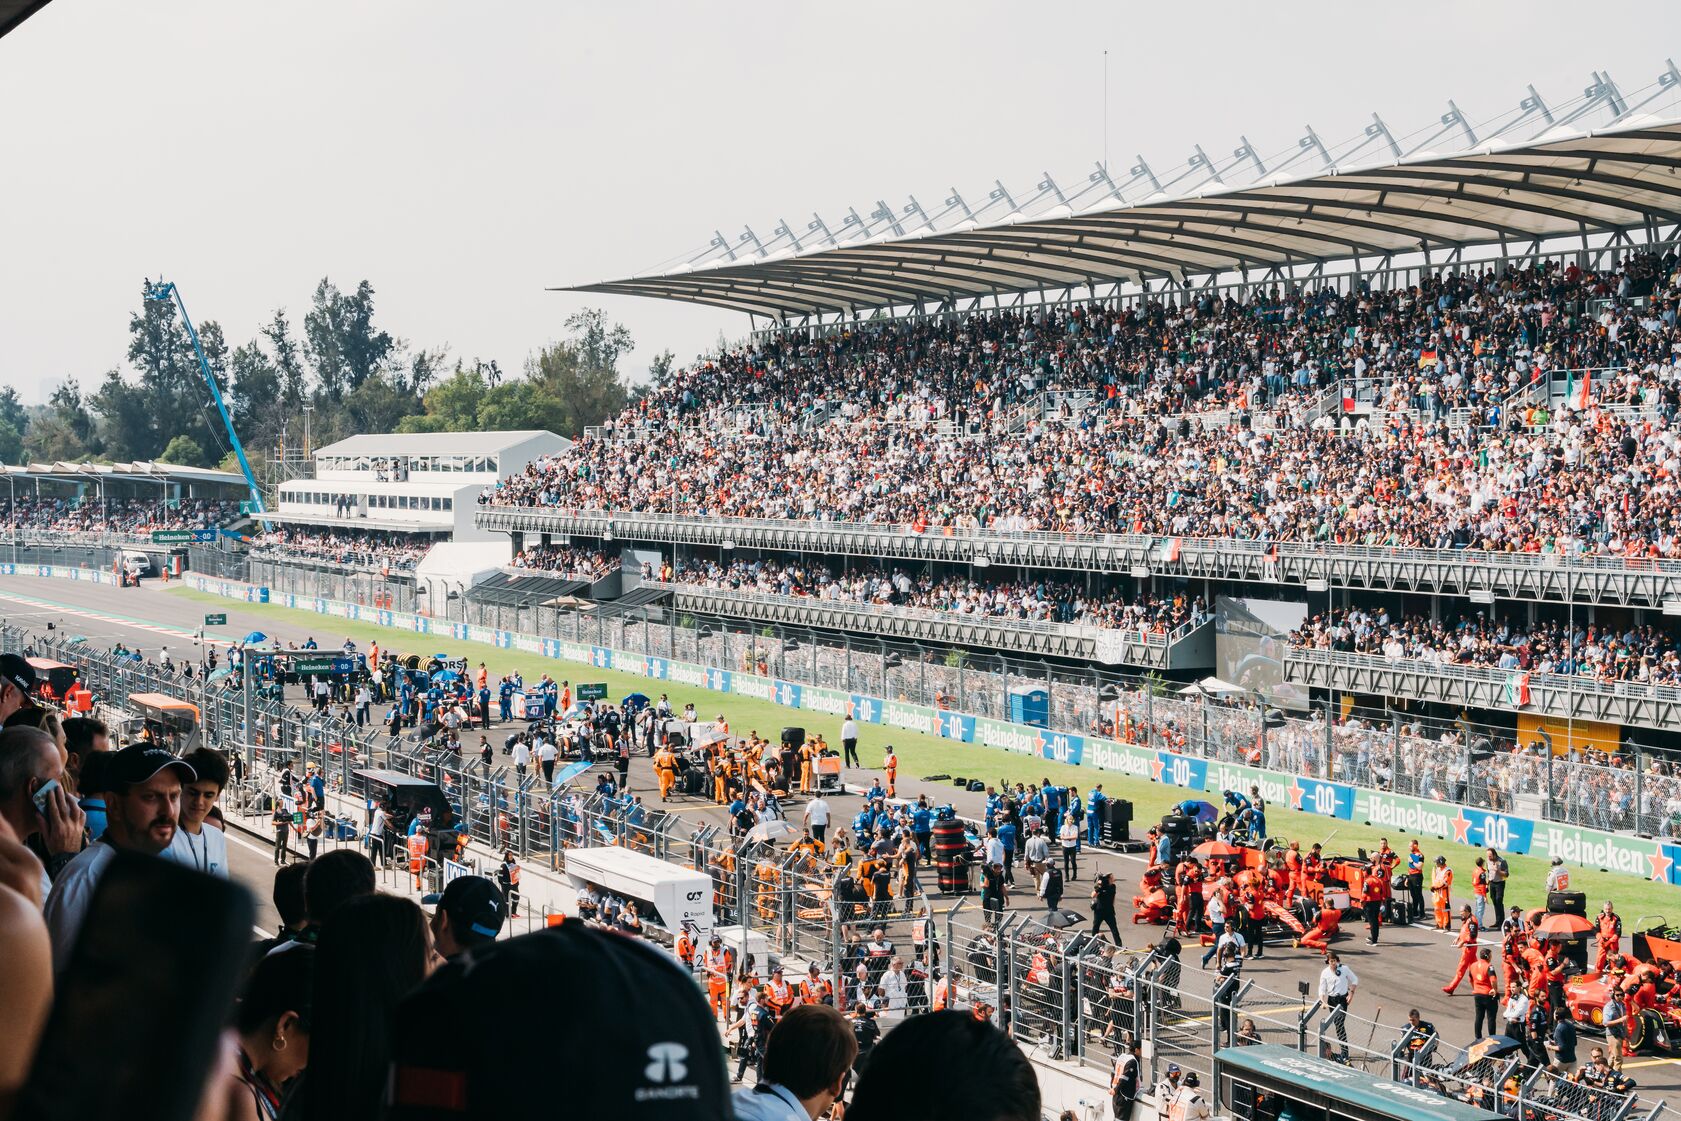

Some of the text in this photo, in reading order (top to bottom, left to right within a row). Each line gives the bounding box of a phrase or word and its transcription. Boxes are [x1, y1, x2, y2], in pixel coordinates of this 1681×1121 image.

[243, 505, 250, 513] A
[671, 663, 702, 685] Heineken
[736, 675, 769, 698] Heineken
[530, 706, 540, 716] 47
[806, 689, 845, 714] Heineken
[889, 704, 931, 732] Heineken
[983, 723, 1032, 752] Heineken
[1092, 743, 1149, 775] Heineken
[1368, 794, 1449, 836] Heineken
[1548, 828, 1645, 874] Heineken
